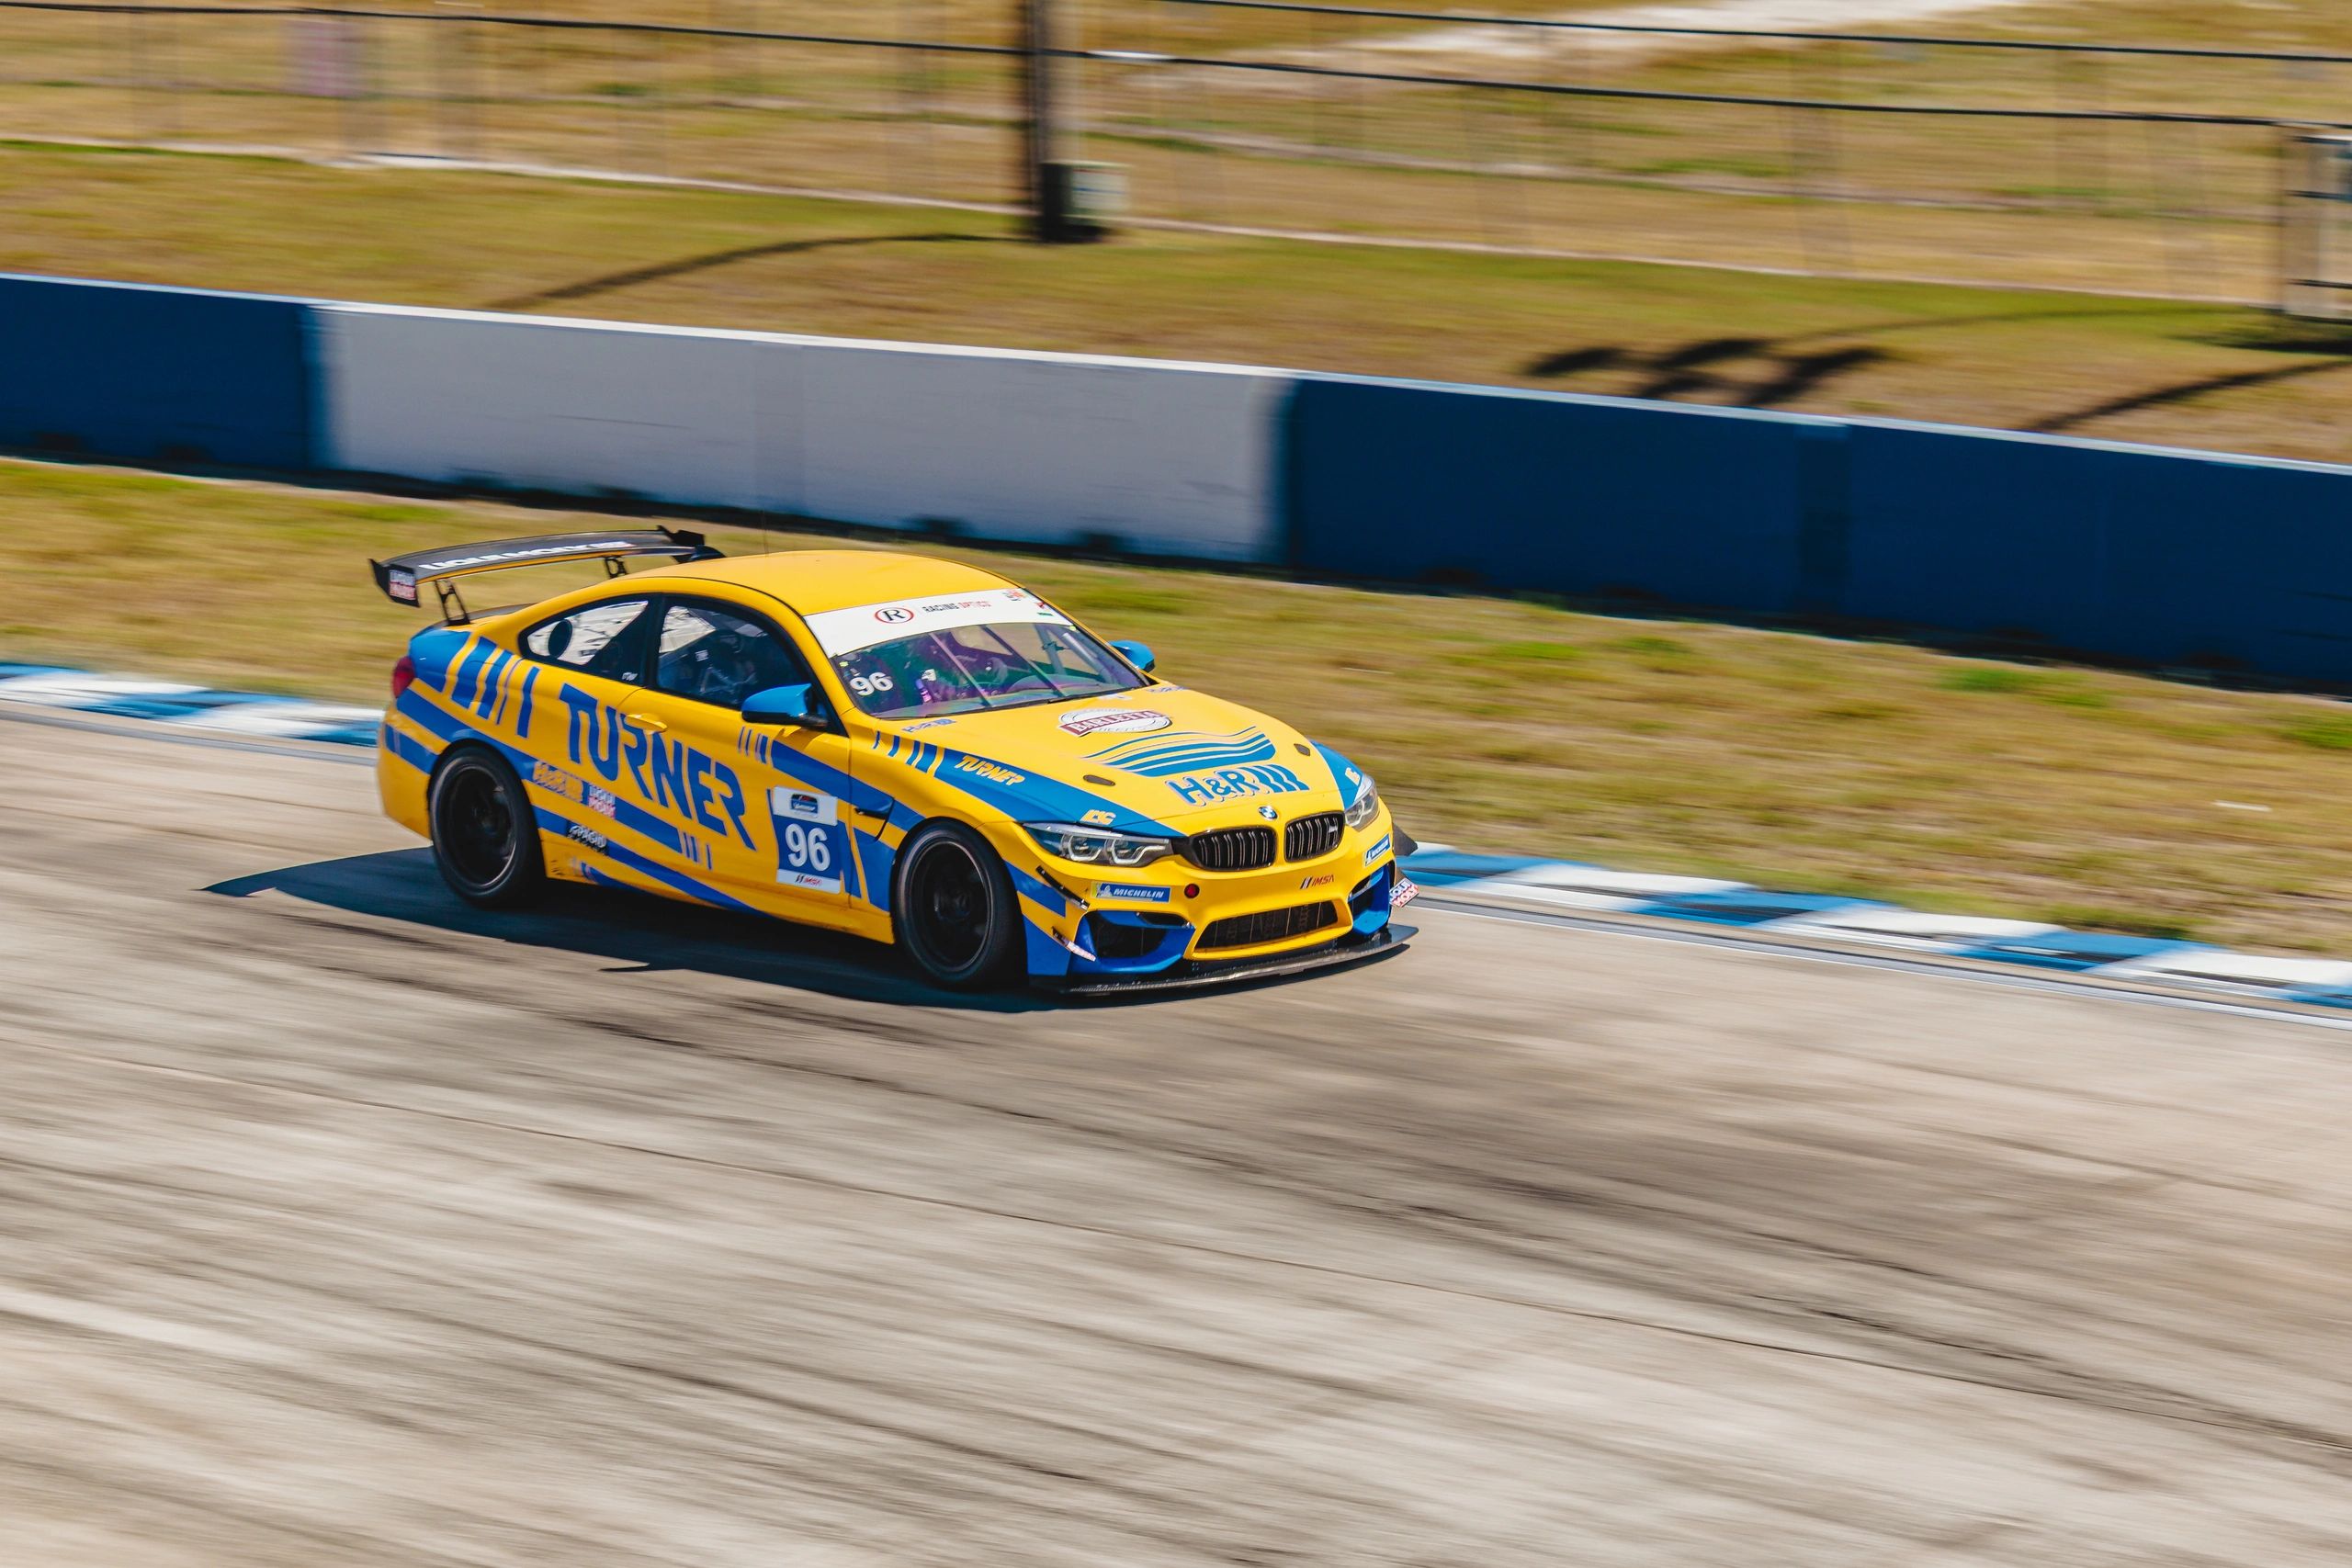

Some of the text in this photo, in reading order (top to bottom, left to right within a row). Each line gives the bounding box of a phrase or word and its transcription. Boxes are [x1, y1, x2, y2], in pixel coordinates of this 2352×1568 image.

[884, 608, 906, 622] R
[849, 672, 893, 696] 96
[1068, 710, 1162, 732] BARLETTA
[559, 682, 757, 852] TURNER
[955, 755, 1025, 785] TURNER
[1166, 770, 1261, 806] H&R
[785, 823, 831, 872] 96
[1113, 887, 1165, 898] MICHELIN
[1311, 874, 1335, 887] IMSA
